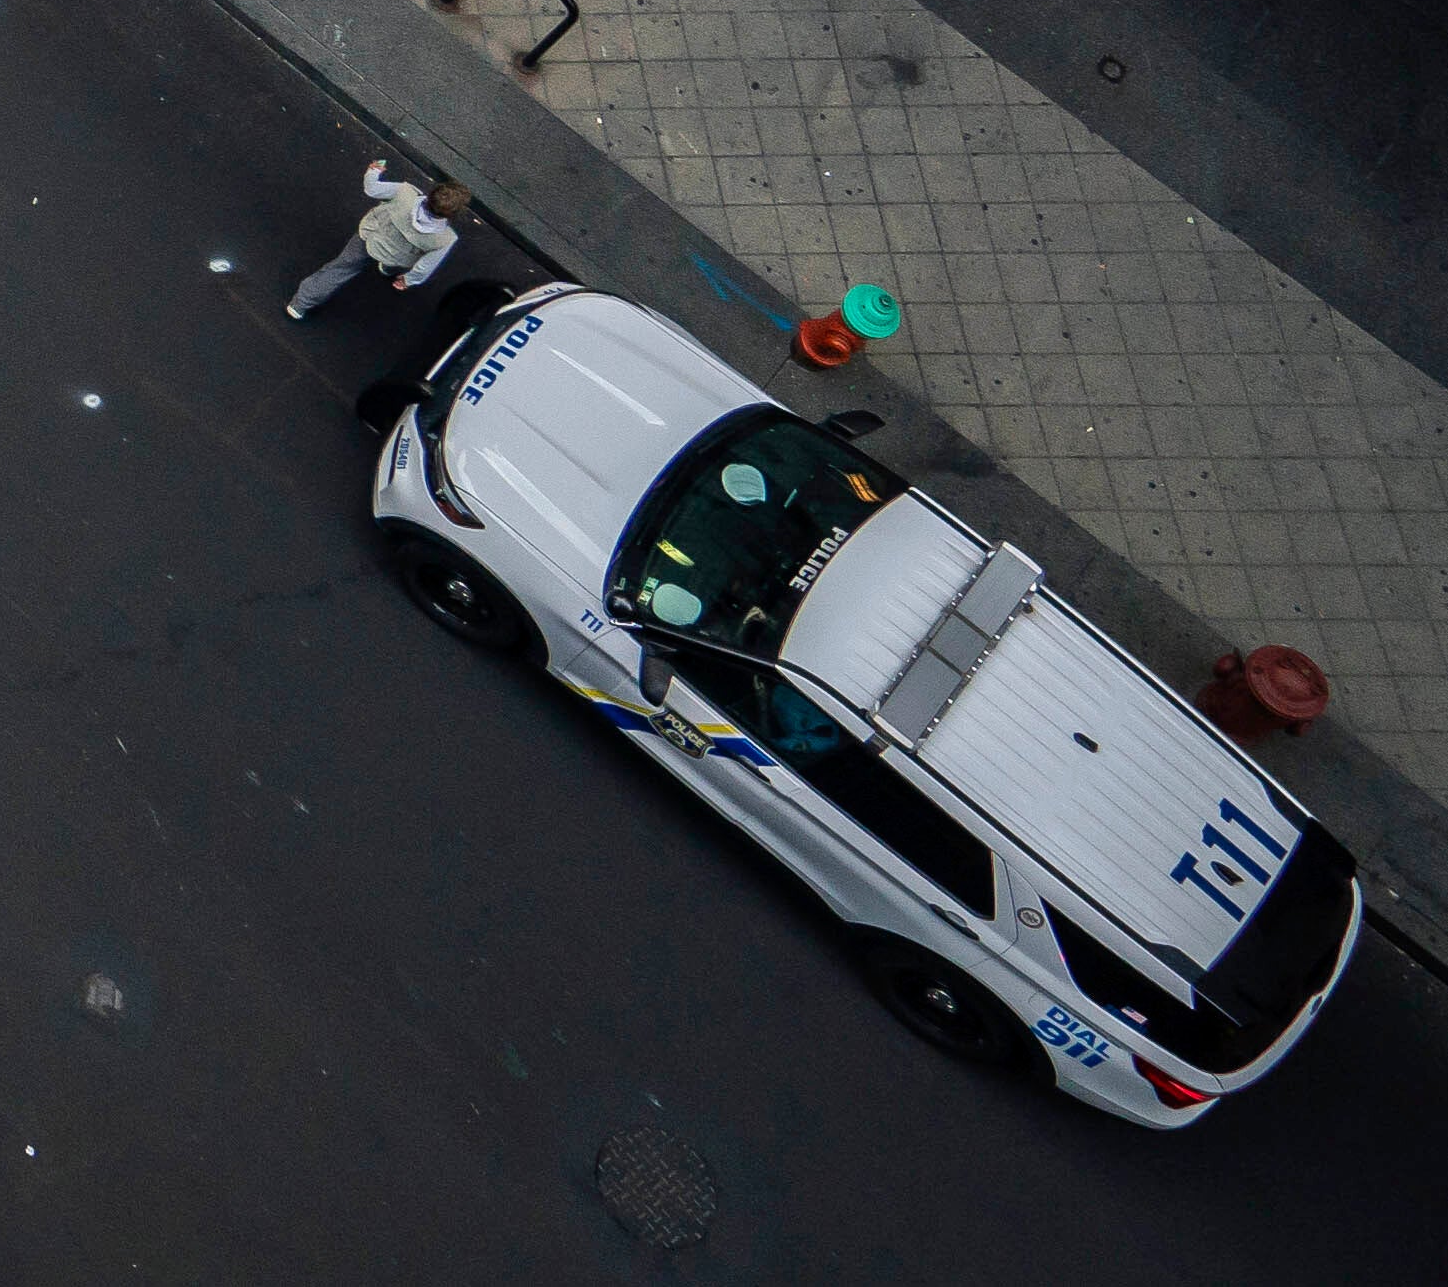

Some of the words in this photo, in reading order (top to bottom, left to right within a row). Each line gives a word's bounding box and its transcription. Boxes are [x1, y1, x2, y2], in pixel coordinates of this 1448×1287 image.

[460, 312, 545, 407] POLICE
[789, 525, 849, 592] POLICE
[577, 606, 605, 635] T11
[663, 713, 707, 748] POLICE
[1029, 1016, 1111, 1070] 911
[1043, 1002, 1112, 1059] DIAL
